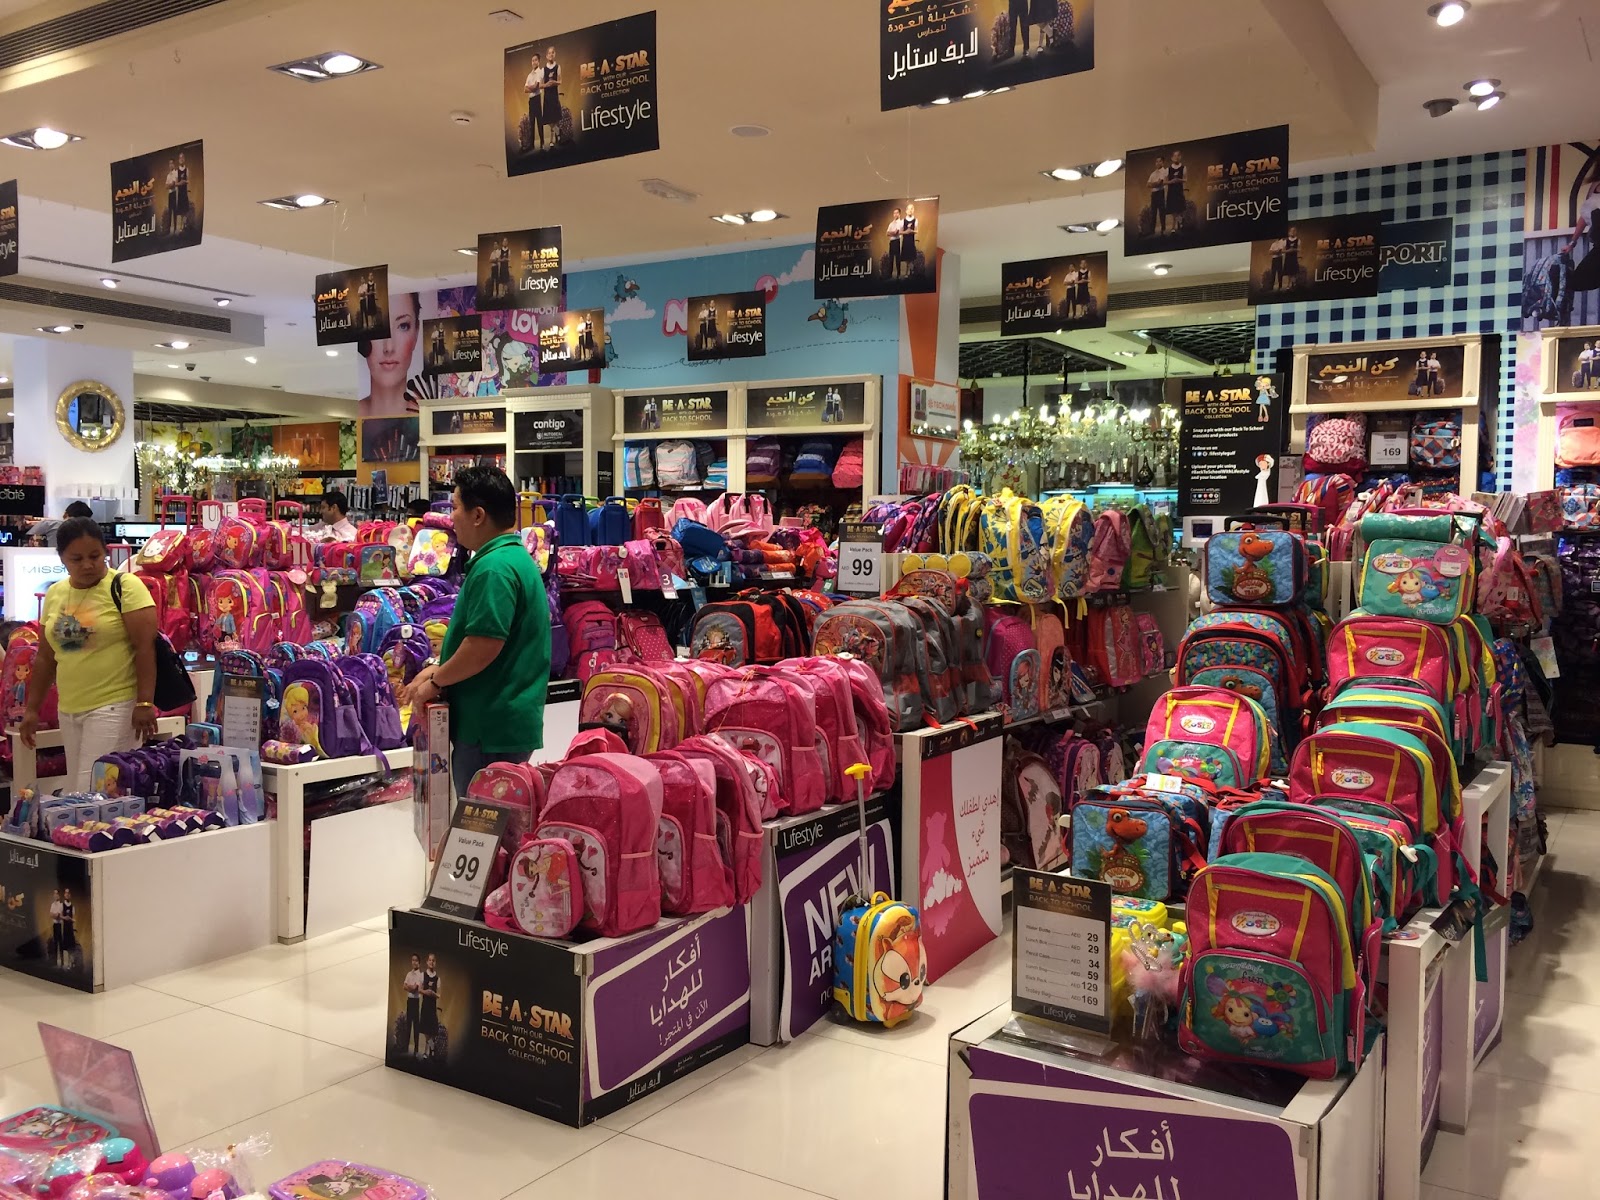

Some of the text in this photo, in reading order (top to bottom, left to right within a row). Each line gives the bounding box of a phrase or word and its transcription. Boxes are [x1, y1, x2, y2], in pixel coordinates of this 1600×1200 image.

[887, 16, 923, 33] العودة
[888, 27, 979, 80] لايف ستايل
[579, 50, 650, 79] BE A STAR
[580, 74, 650, 95] BACK TO SCHOOL
[601, 88, 630, 98] COLLECTION
[580, 99, 651, 131] Lifestyle
[1207, 156, 1280, 177] BE A STAR
[1207, 176, 1280, 192] BACK TO SCHOOL
[1207, 196, 1281, 221] Lifestyle
[115, 221, 138, 243] ستايل
[820, 224, 872, 242] كن النجم
[1317, 235, 1375, 249] BE A STAR
[540, 247, 559, 258] STAR
[1347, 250, 1374, 258] SCHOOL
[819, 258, 872, 281] لايف ستايل
[1314, 265, 1374, 284] Lifestyle
[520, 276, 558, 293] Lifestyle
[1006, 276, 1051, 291] كن النجم
[745, 308, 762, 317] STAR
[1005, 303, 1051, 322] لايف ستايل
[726, 330, 762, 345] Lifestyle
[452, 349, 480, 362] Lifestyle
[1319, 356, 1399, 378] كن النجم
[662, 397, 712, 411] BE A STAR
[766, 391, 815, 406] كن النجم
[1186, 388, 1252, 403] BE A STAR
[533, 419, 565, 430] contigo
[1383, 448, 1401, 456] 169
[852, 559, 873, 576] 99
[662, 574, 670, 585] 3
[481, 809, 498, 820] STAR
[459, 837, 471, 845] Value
[783, 822, 824, 850] Lifestyle
[8, 850, 25, 864] ستايل
[967, 848, 989, 877] متميز
[453, 855, 479, 881] 99
[1029, 877, 1092, 899] BE A STAR
[1062, 901, 1092, 911] SCHOOL
[458, 928, 509, 958] Lifestyle
[1087, 933, 1098, 943] 29
[1088, 945, 1099, 954] 29
[662, 933, 701, 992] أفكار
[1089, 959, 1099, 969] 34
[1087, 971, 1098, 981] 59
[1241, 971, 1264, 984] fun
[1082, 982, 1098, 992] 129
[650, 968, 703, 1027] للهدايا
[1082, 996, 1098, 1006] 169
[482, 990, 574, 1040] BE A STAR
[696, 999, 708, 1019] الآن
[1043, 1005, 1076, 1021] Lifestyle
[686, 1012, 693, 1029] في
[511, 1025, 543, 1040] WITH OUR
[481, 1025, 573, 1064] BACK TO SCHOOL
[508, 1048, 546, 1066] COLLECTION
[627, 1079, 647, 1102] ستايل
[1090, 1120, 1174, 1167] أفكار
